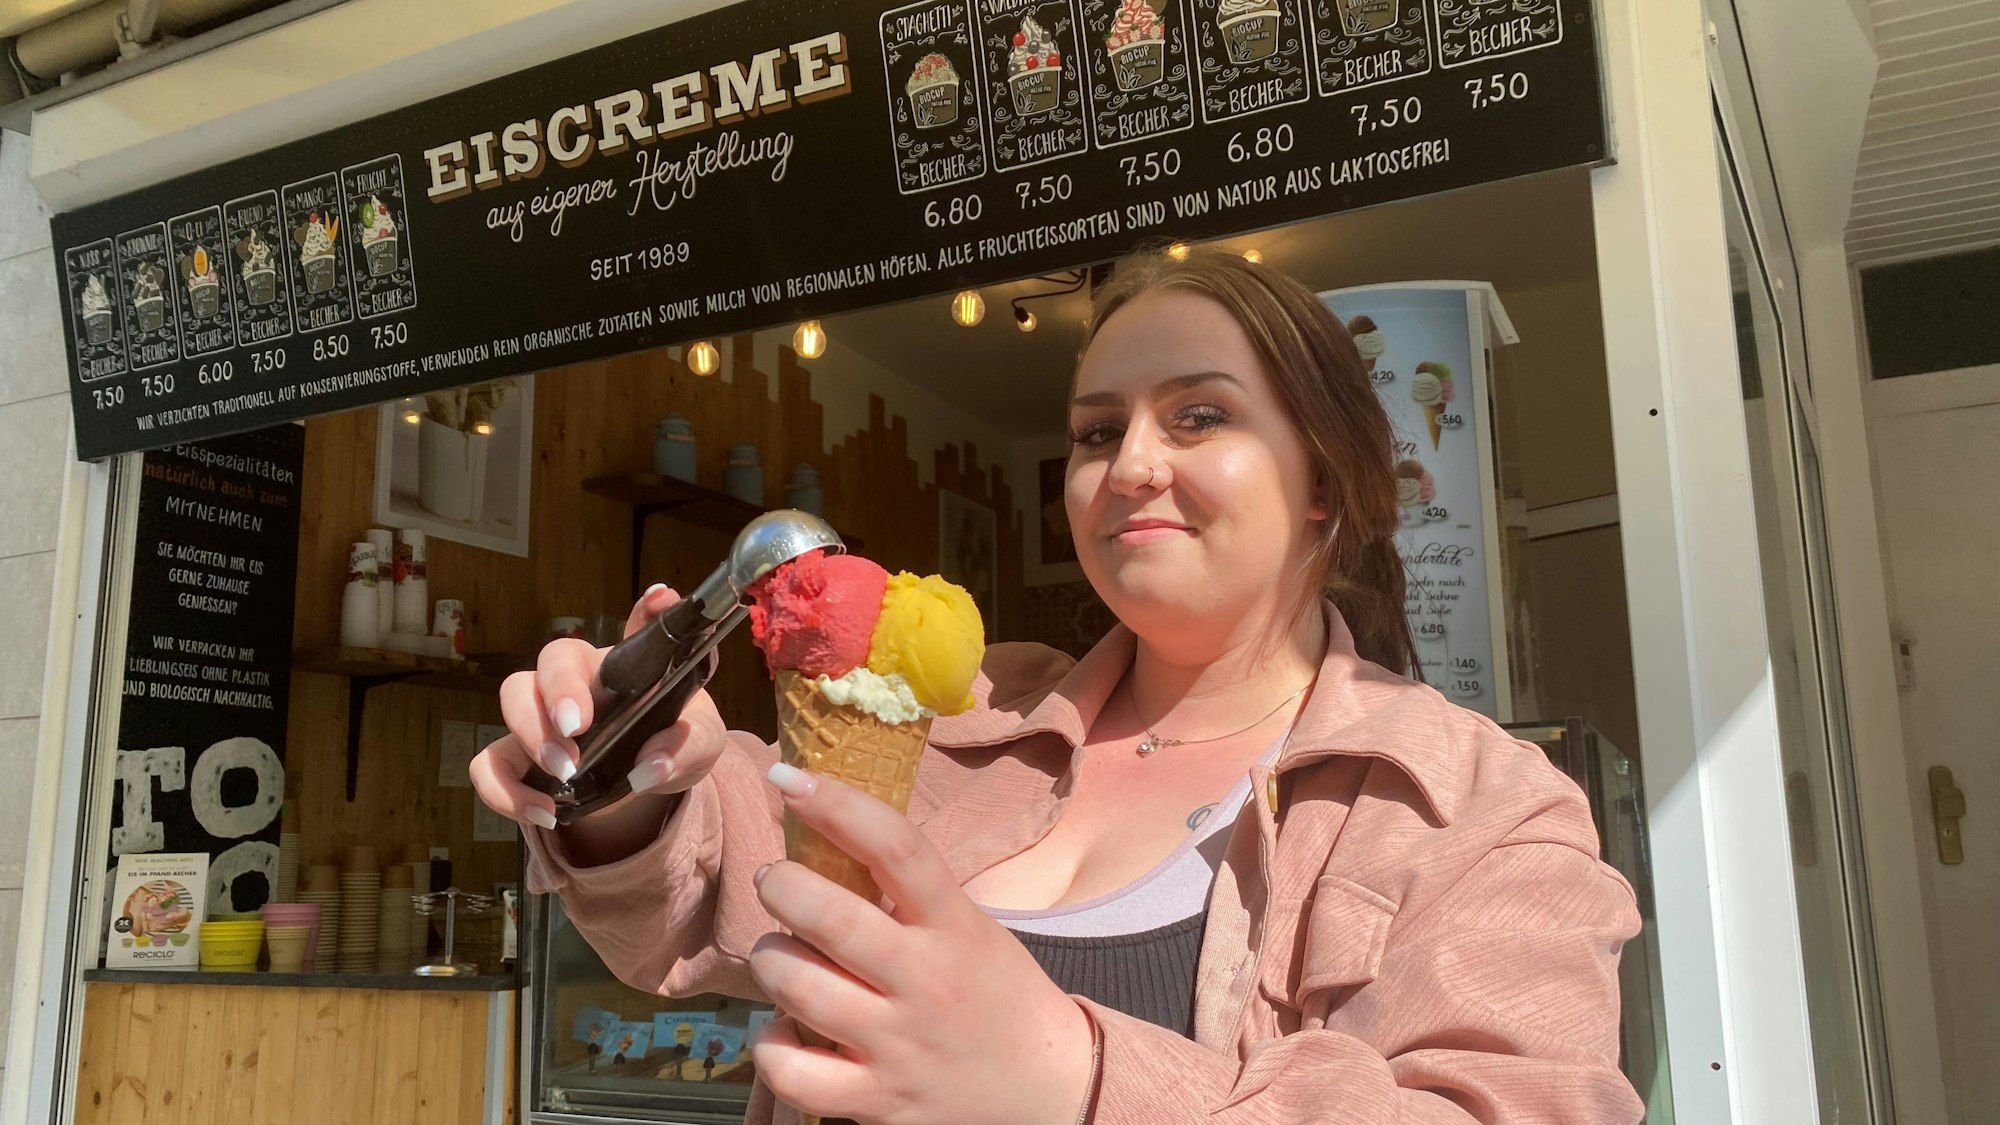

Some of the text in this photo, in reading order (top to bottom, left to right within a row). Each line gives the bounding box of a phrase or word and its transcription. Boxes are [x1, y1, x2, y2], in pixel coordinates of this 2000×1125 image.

[896, 7, 951, 42] SPAGHETTI
[1232, 18, 1263, 37] BIOCUP
[1468, 18, 1533, 56] BECHER
[1017, 73, 1045, 91] BIOCUP
[1343, 49, 1403, 87] BECHER
[919, 86, 945, 105] BIOCUP
[1228, 78, 1284, 114] BECHER
[1464, 71, 1530, 109] 7,50
[424, 31, 850, 202] EISCREME
[1118, 105, 1170, 139] BECHER
[1350, 96, 1423, 137] 7,50
[1018, 128, 1067, 162] BECHER
[1227, 123, 1295, 163] 6,80
[357, 169, 387, 193] FRUCHT
[919, 154, 966, 187] BECHER
[1119, 148, 1182, 187] 7,50
[530, 178, 617, 236] eigener
[627, 131, 795, 216] Herstellung
[1015, 173, 1073, 210] 7,50
[296, 187, 324, 210] MANGO
[924, 194, 984, 228] 6,80
[238, 205, 263, 227] BUENO
[590, 241, 691, 281] SEIT 1989
[136, 137, 1451, 431] WIR VERZICHTEN TRADITIONELL AUF KONSERVIERUNGSTOFFE, VERWENDEN REIN ORGANISCHE ZUTATEN SOWIE MILCH VON REGIONALEN HÖFEN. ALLE FRUCHTEISSORTEN SIND VON NATUR AUS LAKTOSEFREI
[372, 289, 403, 314] BECHER
[251, 318, 281, 341] BECHER
[310, 304, 340, 328] BECHER
[195, 328, 222, 351] BECHER
[371, 322, 408, 350] 7,50
[90, 355, 117, 378] BECHER
[141, 342, 168, 363] BECHER
[251, 348, 286, 373] 7,50
[141, 373, 175, 398] 7,50
[198, 360, 233, 385] 6,00
[92, 385, 125, 411] 7,50
[144, 460, 216, 493] natürlich
[221, 481, 254, 500] auch
[165, 496, 263, 532] MITNEHMEN
[157, 541, 264, 575] SIE MÖCHTEN IHR EIS
[169, 568, 250, 595] GERNE ZUHAUSE
[1427, 590, 1460, 601] Sahne
[1438, 576, 1466, 587] nach
[178, 592, 238, 615] GENIESSEN?
[1407, 605, 1452, 618] nd Soße
[152, 635, 255, 662] WIR VERPACKEN IHR
[129, 657, 270, 686] LIEBLINGSEIS OHNE PLASTIK
[122, 679, 274, 710] UND BIOLOGISCH NACHHALTIG.
[112, 736, 285, 857] TO
